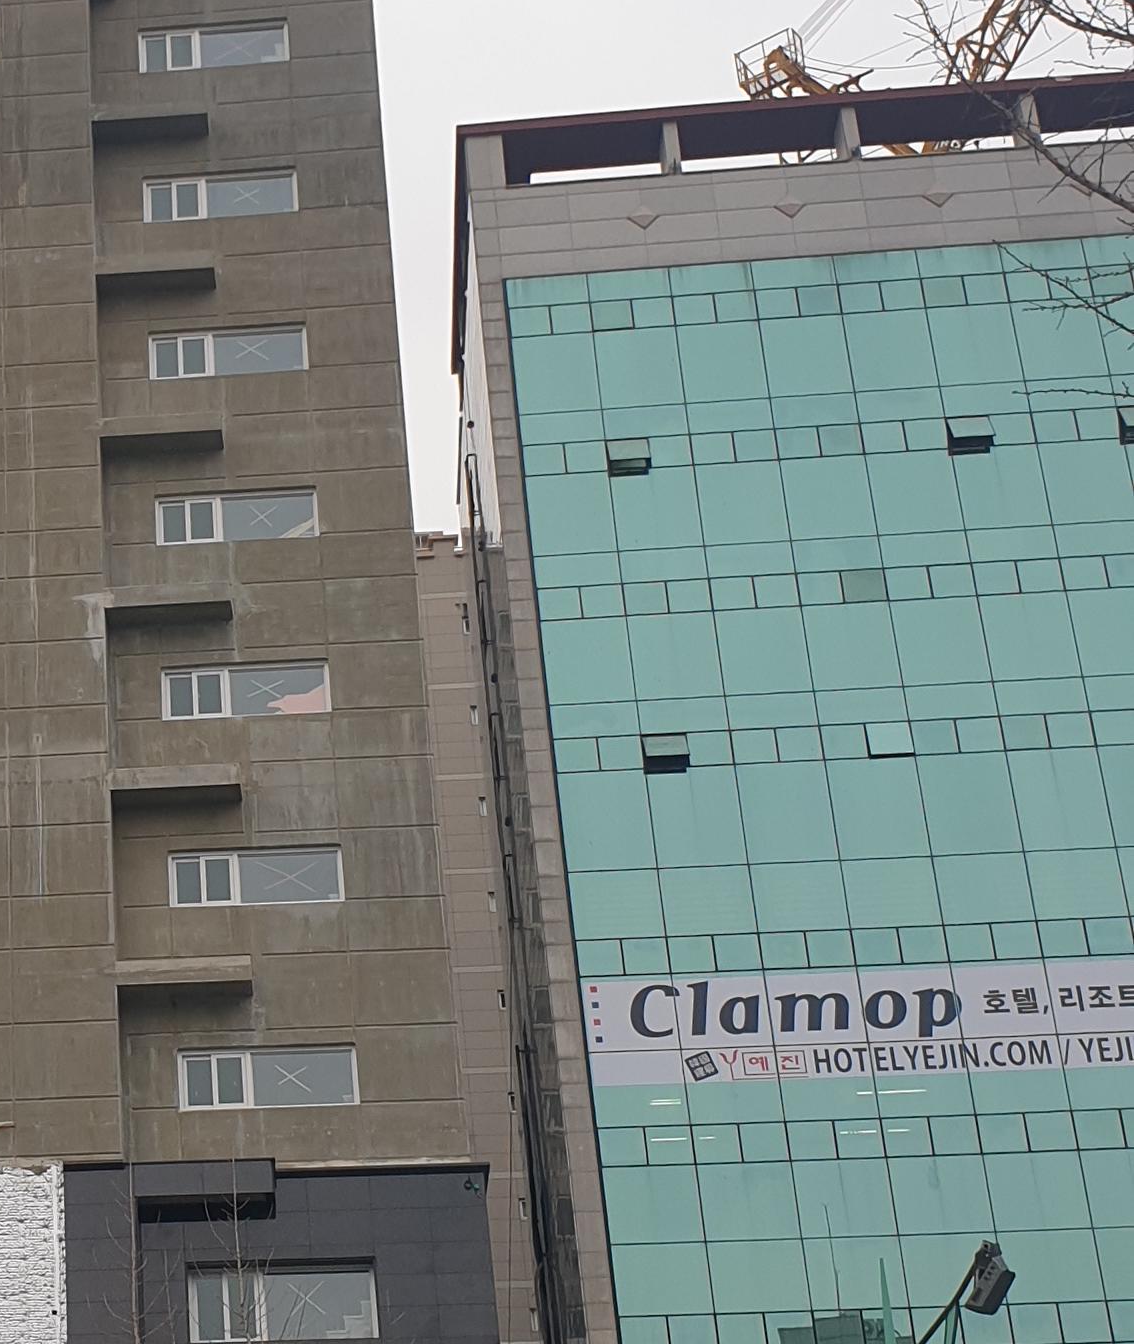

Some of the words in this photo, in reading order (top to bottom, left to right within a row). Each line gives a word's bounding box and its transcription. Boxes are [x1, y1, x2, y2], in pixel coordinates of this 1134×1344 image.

[629, 980, 963, 1038] Clamop
[982, 987, 1049, 1015] 호텔,
[1058, 985, 1134, 1012] 리조트
[814, 1039, 1053, 1075] HOTELYEJIN.COM
